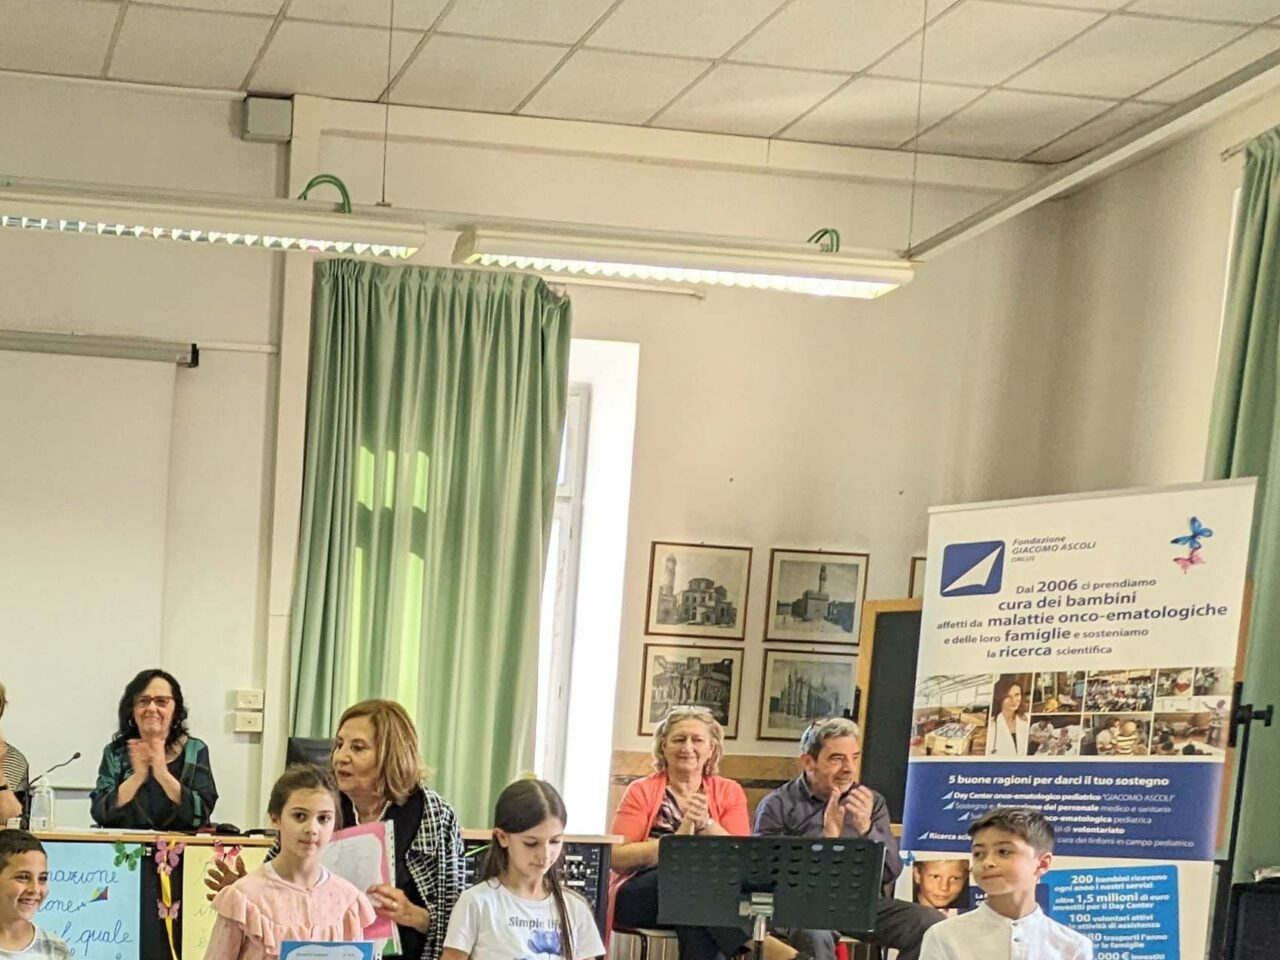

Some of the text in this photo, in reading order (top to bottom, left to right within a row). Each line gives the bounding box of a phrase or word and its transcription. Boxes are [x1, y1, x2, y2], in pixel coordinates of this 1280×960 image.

[1012, 536, 1066, 546] Fondazione
[1012, 541, 1097, 555] GIACOMO ASCOLI
[1016, 578, 1157, 595] Dal 2006 ci prendiamo
[998, 590, 1137, 612] cura dei bambini
[936, 603, 1228, 630] affetti da malattie onco-ematologiche
[951, 634, 978, 645] delle
[979, 634, 1001, 644] loro
[1004, 628, 1071, 644] famiglie
[1082, 628, 1150, 638] sosteniamo
[986, 644, 1113, 659] la ricerca scientifica
[948, 774, 1170, 788] 5 buone ragioni per darci il tuo sostegno
[953, 791, 968, 800] Day
[969, 792, 994, 800] Center
[994, 791, 1062, 802] onco-ematologico
[1062, 792, 1102, 802] pediatrico
[1043, 802, 1057, 811] del
[1057, 804, 1100, 812] personale
[1044, 814, 1152, 824] nco-ematologica pediatrica
[1072, 826, 1125, 834] volontariato
[928, 832, 956, 840] Ricerca
[1125, 840, 1153, 848] campo
[1154, 839, 1194, 848] pediatrico
[1071, 874, 1094, 884] 200
[1095, 874, 1130, 883] bambini
[1054, 885, 1073, 893] ogni
[1100, 882, 1125, 890] nostri
[1126, 882, 1154, 890] servizi
[1076, 894, 1094, 904] 1,5
[1096, 892, 1138, 903] milioni
[1086, 904, 1100, 912] per
[1108, 902, 1125, 911] Day
[1126, 902, 1154, 910] Center
[508, 916, 545, 931] Simple
[1070, 914, 1091, 922] 100
[1092, 914, 1130, 922] volontari
[75, 920, 133, 957] quale
[1110, 942, 1145, 950] famiglie
